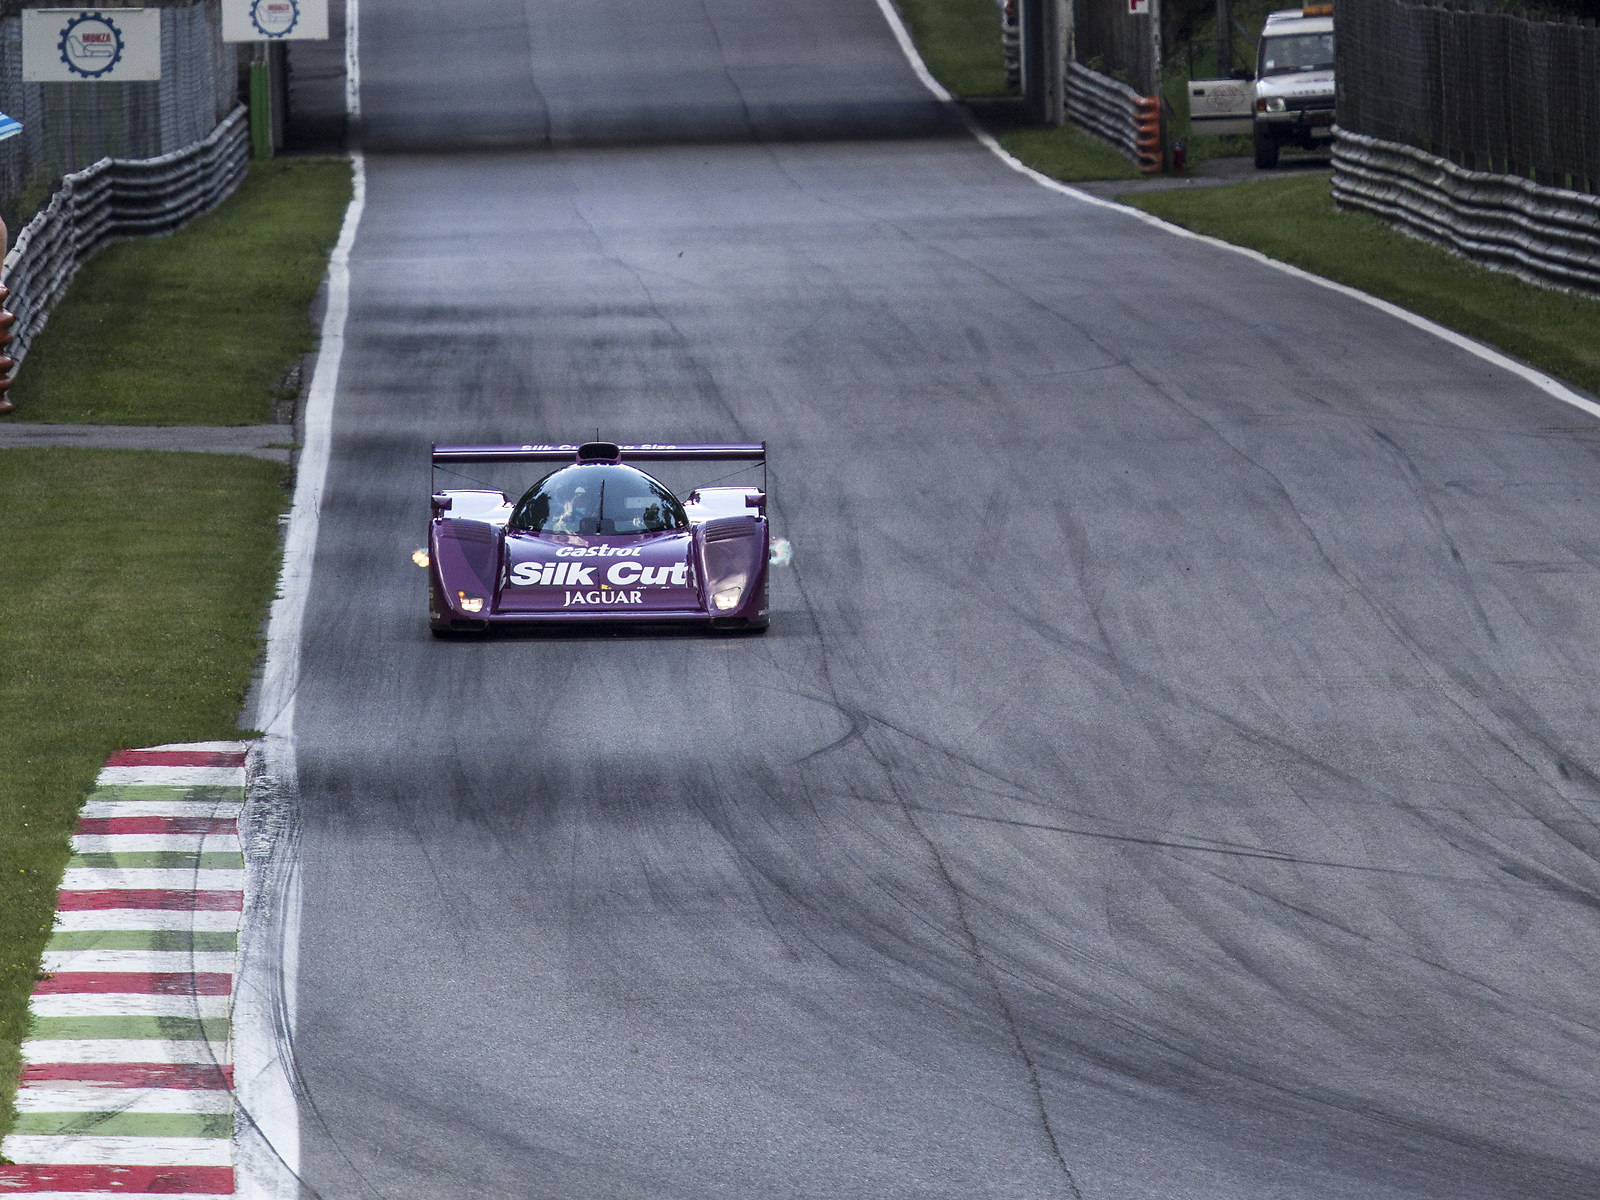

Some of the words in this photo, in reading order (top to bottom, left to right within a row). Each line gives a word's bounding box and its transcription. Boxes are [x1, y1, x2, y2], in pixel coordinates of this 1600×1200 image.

[82, 33, 111, 43] MONZA
[555, 543, 642, 557] Castrol
[510, 561, 597, 586] Silk
[607, 561, 688, 586] Cut
[563, 591, 642, 607] JAGUAR
